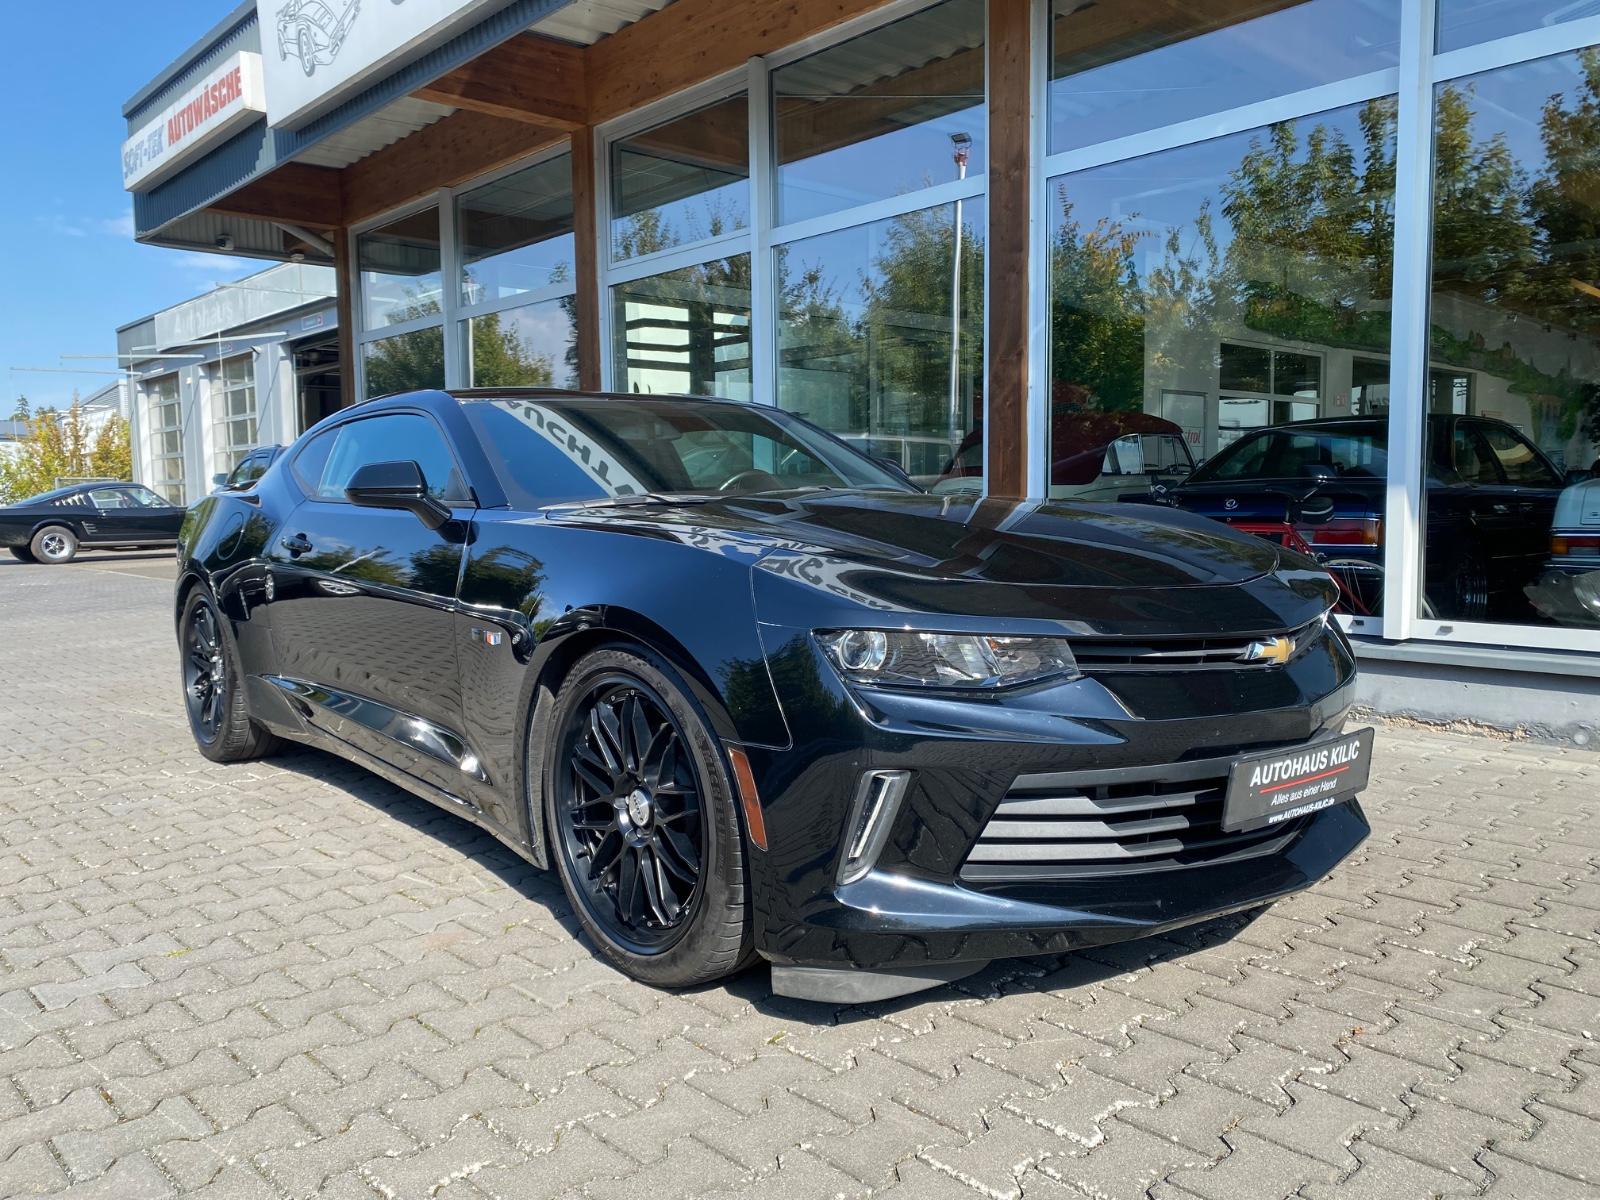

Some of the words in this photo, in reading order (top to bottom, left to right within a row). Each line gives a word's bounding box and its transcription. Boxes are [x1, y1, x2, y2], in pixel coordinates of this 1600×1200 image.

[168, 66, 242, 148] AUTOWÄSCHE
[1250, 751, 1329, 787] AUTOHAUS
[1330, 740, 1360, 767] KILIC
[1271, 794, 1290, 806] Alles
[1289, 790, 1303, 802] aus
[1303, 785, 1320, 798] einer
[1320, 778, 1338, 792] Hand
